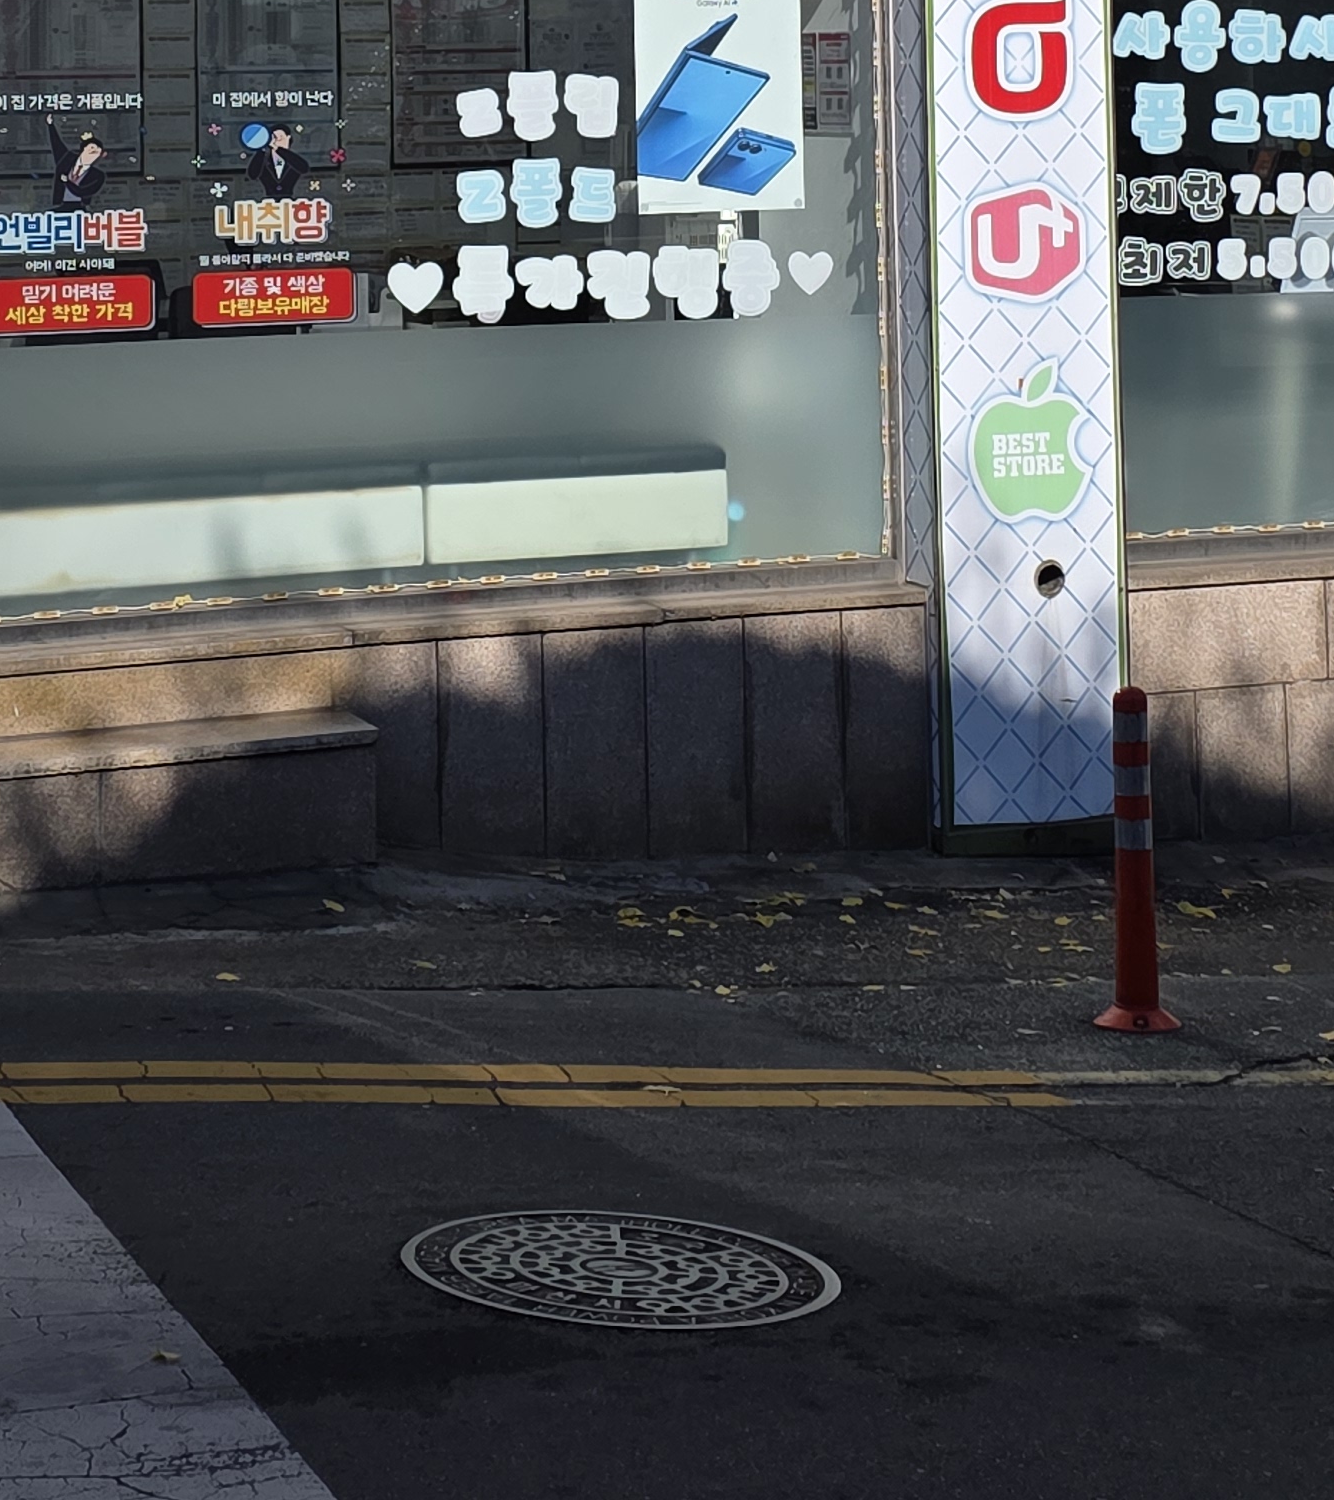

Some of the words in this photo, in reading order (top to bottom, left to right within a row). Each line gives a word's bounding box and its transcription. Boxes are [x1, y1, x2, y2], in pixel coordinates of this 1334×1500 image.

[11, 94, 25, 110] 집
[28, 95, 73, 111] 가격은
[77, 93, 143, 110] 거품입니다
[230, 92, 271, 108] 집에서
[275, 91, 303, 107] 향이
[307, 91, 334, 106] 난다
[1132, 82, 1186, 154] 폰
[456, 170, 506, 223] Z
[510, 158, 616, 228] 폴드
[214, 198, 332, 245] 내취향
[1119, 236, 1211, 286] 최저
[22, 284, 56, 304] 믿기
[62, 282, 116, 301] 어려운
[223, 276, 259, 296] 기종
[264, 276, 281, 295] 및
[287, 274, 325, 293] 색상
[5, 305, 46, 325] 세상
[52, 304, 90, 323] 착한
[95, 302, 133, 321] 가격
[219, 296, 329, 317] 다량보유매장
[992, 431, 1050, 455] BEST
[992, 454, 1065, 479] STORE
